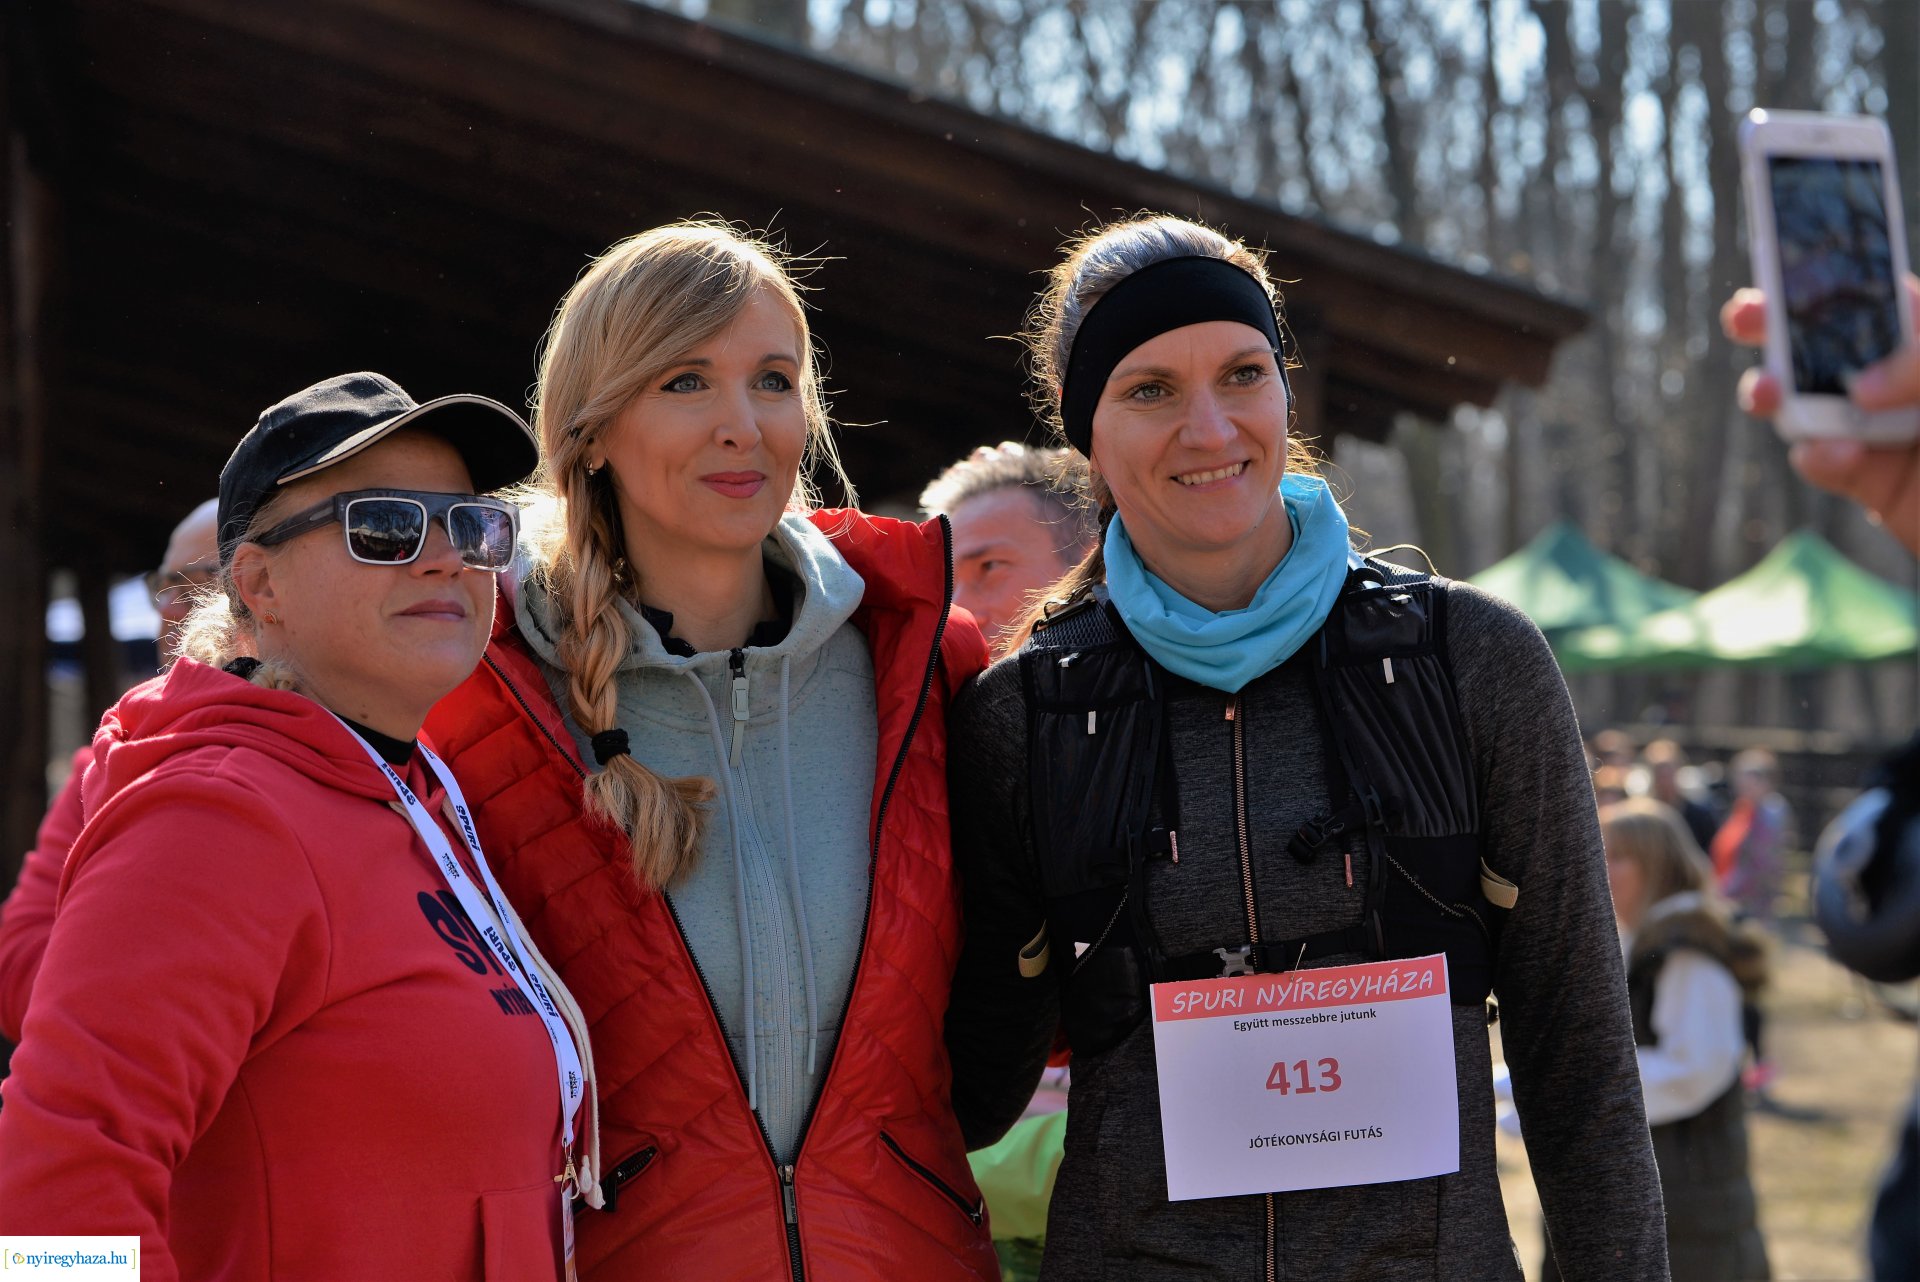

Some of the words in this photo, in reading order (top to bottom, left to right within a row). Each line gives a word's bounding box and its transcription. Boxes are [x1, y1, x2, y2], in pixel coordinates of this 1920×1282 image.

[1172, 988, 1244, 1014] SPURI
[1256, 968, 1433, 1007] NYÍREGYHÁZA
[1233, 1018, 1270, 1031] Együtt
[1271, 1010, 1339, 1027] messzebbre
[1339, 1008, 1377, 1024] jutunk
[1265, 1057, 1342, 1096] 413
[1249, 1130, 1341, 1149] JÓTÉKONYSÁGI
[1343, 1126, 1383, 1142] FUTÁS
